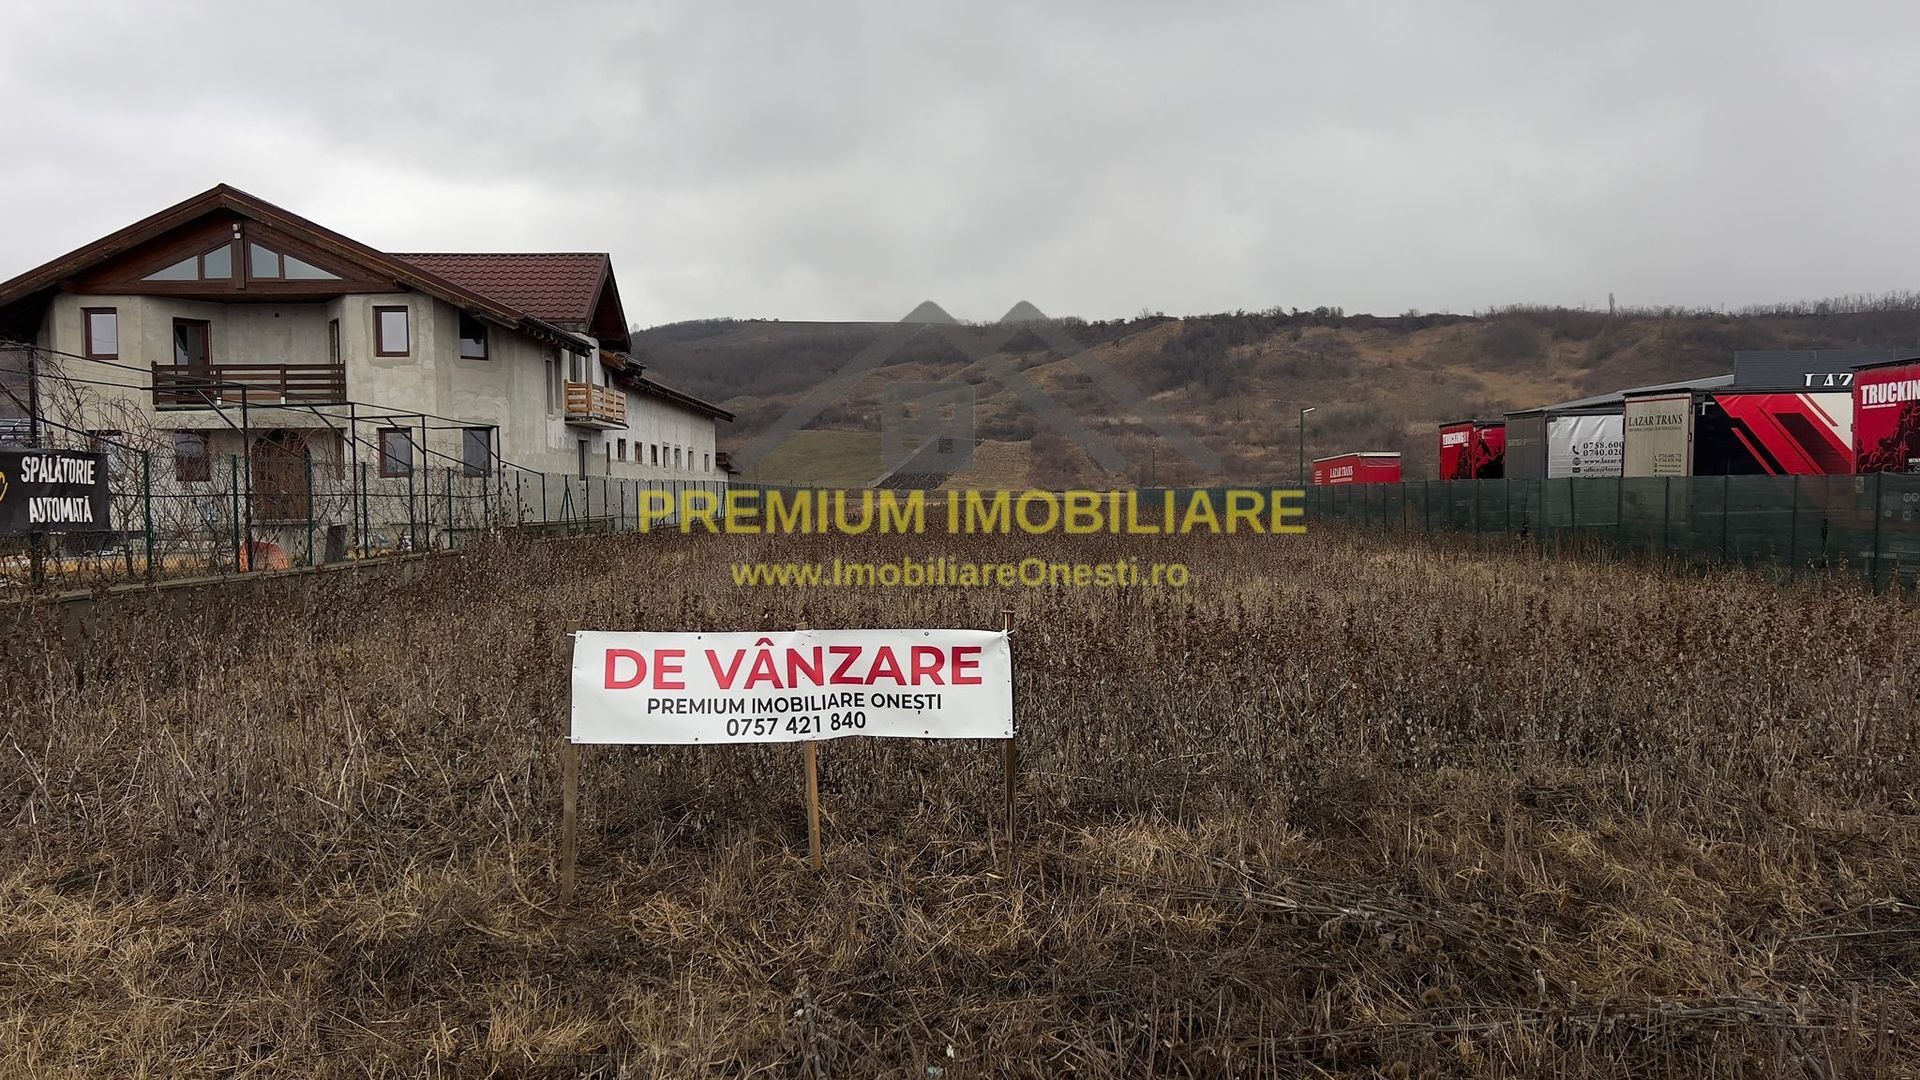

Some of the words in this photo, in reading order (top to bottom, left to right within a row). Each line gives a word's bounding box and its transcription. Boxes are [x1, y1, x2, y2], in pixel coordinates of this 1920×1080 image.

[1628, 416, 1654, 427] LAZAR
[1656, 413, 1683, 425] TRANS
[21, 454, 96, 485] SPĂLĂTORIE
[29, 496, 94, 523] AUTOMATĂ
[604, 648, 686, 690] DE
[704, 637, 983, 690] VÂNZARE
[647, 697, 745, 714] PREMIUM
[751, 692, 865, 714] IMOBILIARE
[871, 693, 942, 715] ONEȘTI
[726, 717, 778, 736] 0757
[785, 714, 821, 734] 421
[830, 711, 866, 731] 840
